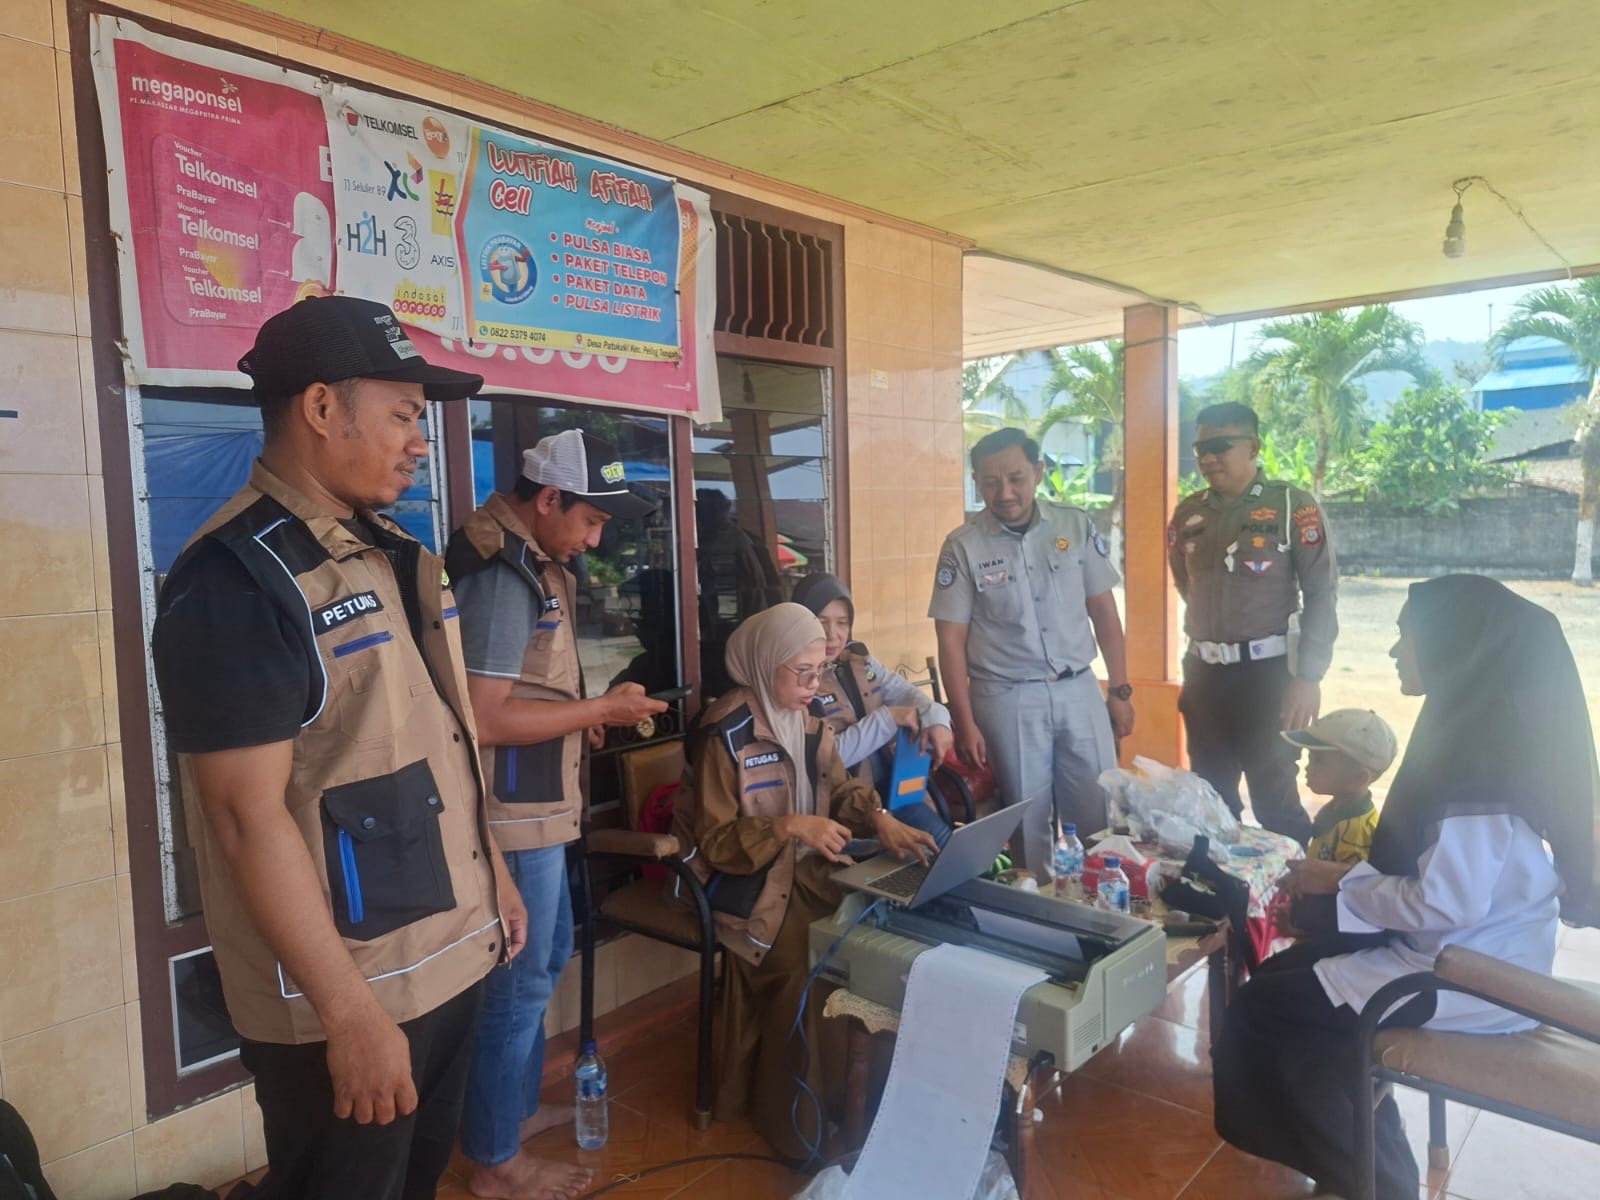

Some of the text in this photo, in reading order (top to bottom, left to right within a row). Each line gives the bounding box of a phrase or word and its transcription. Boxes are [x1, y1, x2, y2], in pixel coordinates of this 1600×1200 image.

[131, 76, 242, 113] megaponsel
[363, 115, 419, 140] TELKOMSEL
[174, 140, 203, 158] Voucher
[175, 152, 258, 199] Telkomsel
[176, 184, 217, 205] PraBayar
[376, 185, 386, 197] 89
[490, 180, 533, 215] Cell
[177, 201, 206, 217] Voucher
[177, 212, 260, 250] Telkomsel
[346, 212, 387, 256] H2H
[394, 215, 421, 270] 3
[563, 233, 651, 264] PULSA BIASA
[178, 247, 218, 264] PraBayar
[430, 254, 455, 268] AXIS
[182, 264, 209, 277] Voucher
[564, 253, 668, 288] PAKET TELEPON
[184, 276, 263, 304] Telkomsel
[396, 288, 446, 302] indosat
[565, 274, 648, 301] PAKET DATA
[188, 307, 228, 320] PraBayar
[393, 299, 446, 317] ooredoo
[564, 294, 661, 322] PULSA LISTRIK
[490, 327, 547, 343] 0822 5379 4074
[978, 559, 1005, 569] IWAN
[745, 753, 779, 769] PETUGAS
